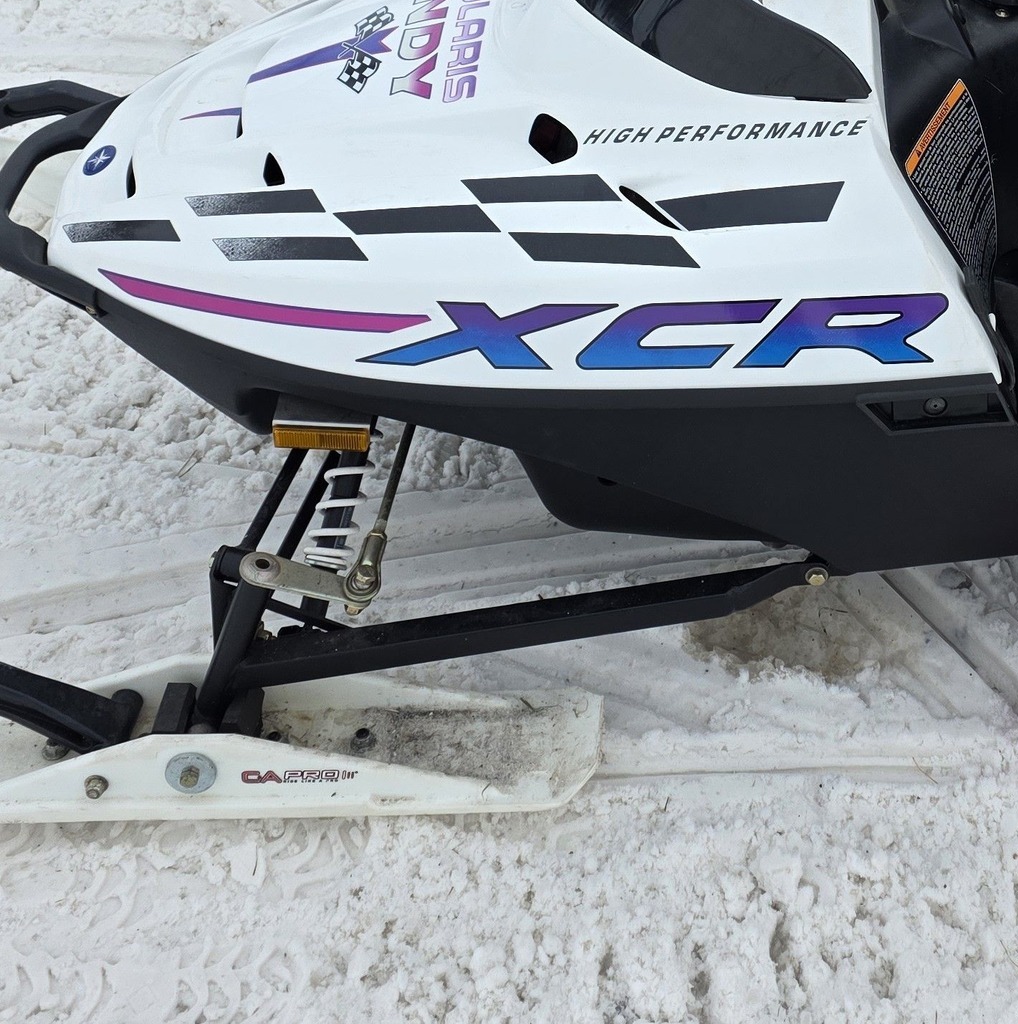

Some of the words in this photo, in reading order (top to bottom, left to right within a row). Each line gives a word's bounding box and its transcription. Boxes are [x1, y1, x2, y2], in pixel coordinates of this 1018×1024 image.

[583, 127, 654, 145] HIGH
[655, 119, 868, 144] PERFORMANCE
[919, 102, 951, 152] AVERTISSEMENT
[355, 293, 950, 370] XCR
